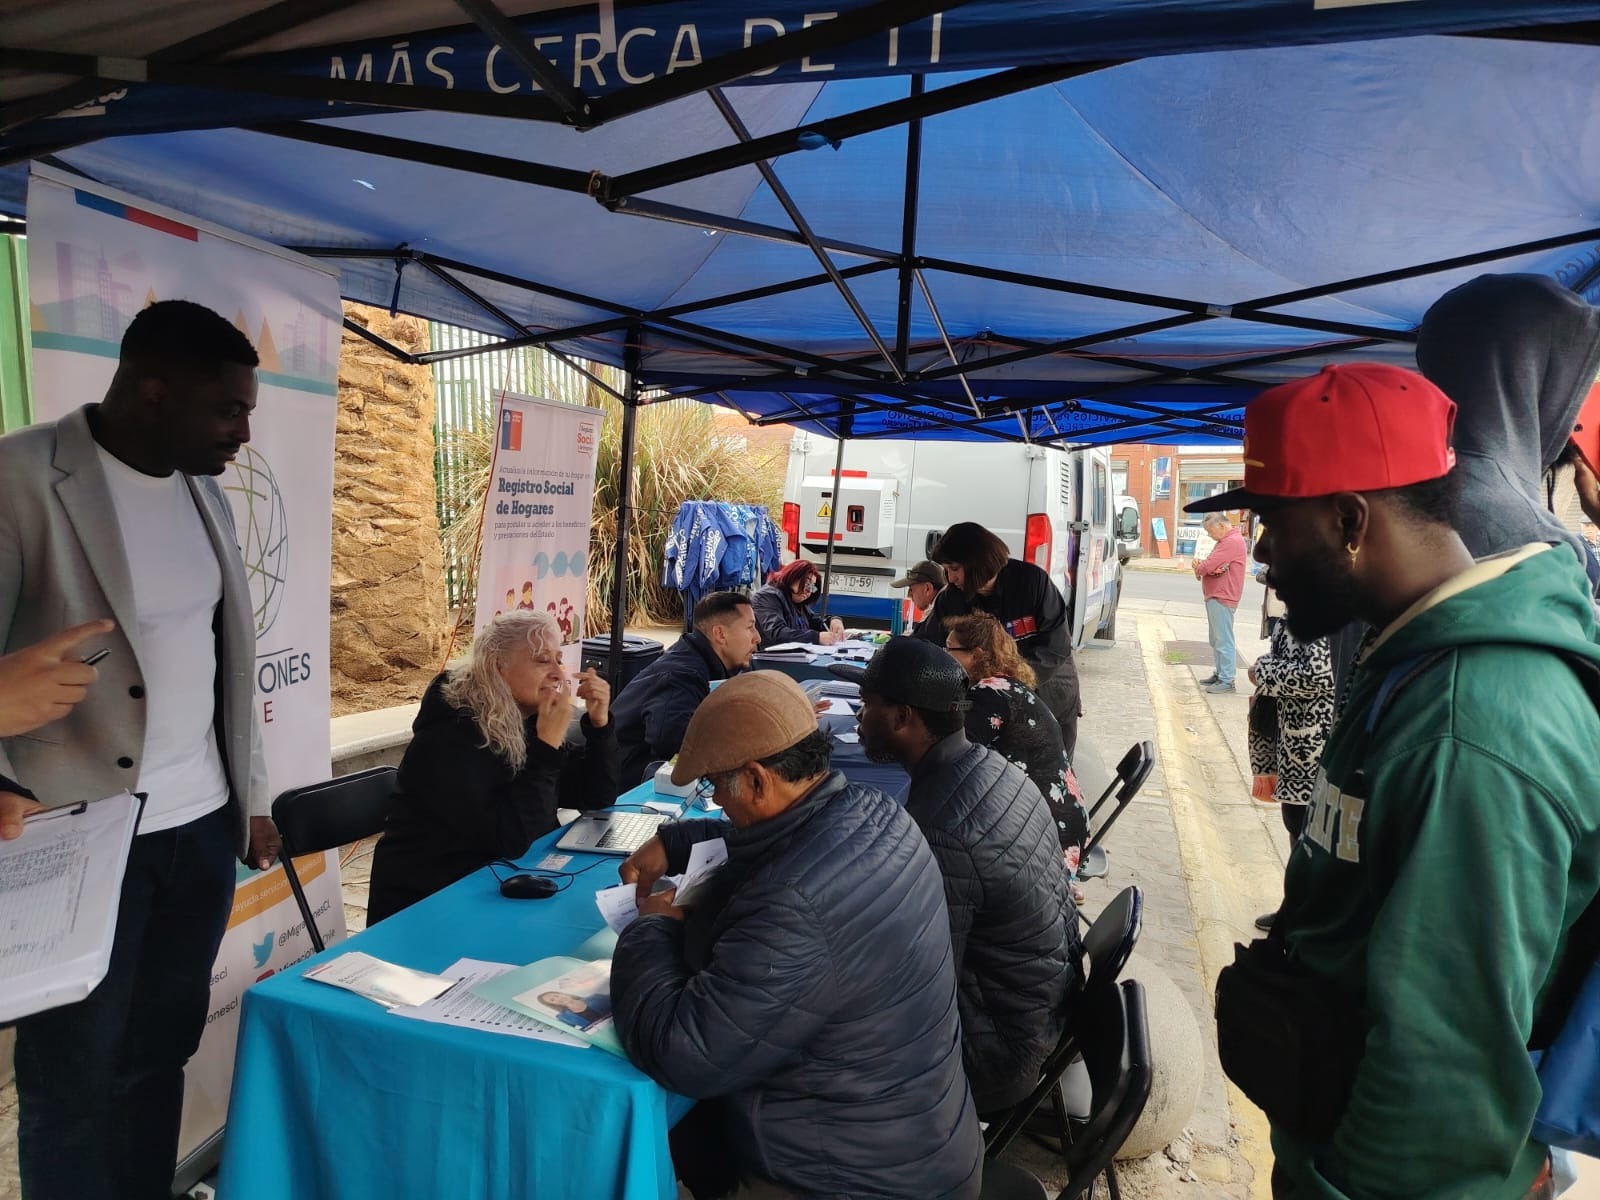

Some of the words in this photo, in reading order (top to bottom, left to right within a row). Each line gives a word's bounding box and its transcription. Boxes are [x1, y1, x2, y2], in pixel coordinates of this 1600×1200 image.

[485, 22, 703, 95] CERCA
[498, 477, 542, 496] Registro
[544, 480, 574, 495] Social
[496, 500, 509, 514] de
[511, 500, 554, 518] Hogares
[254, 652, 310, 696] ONES
